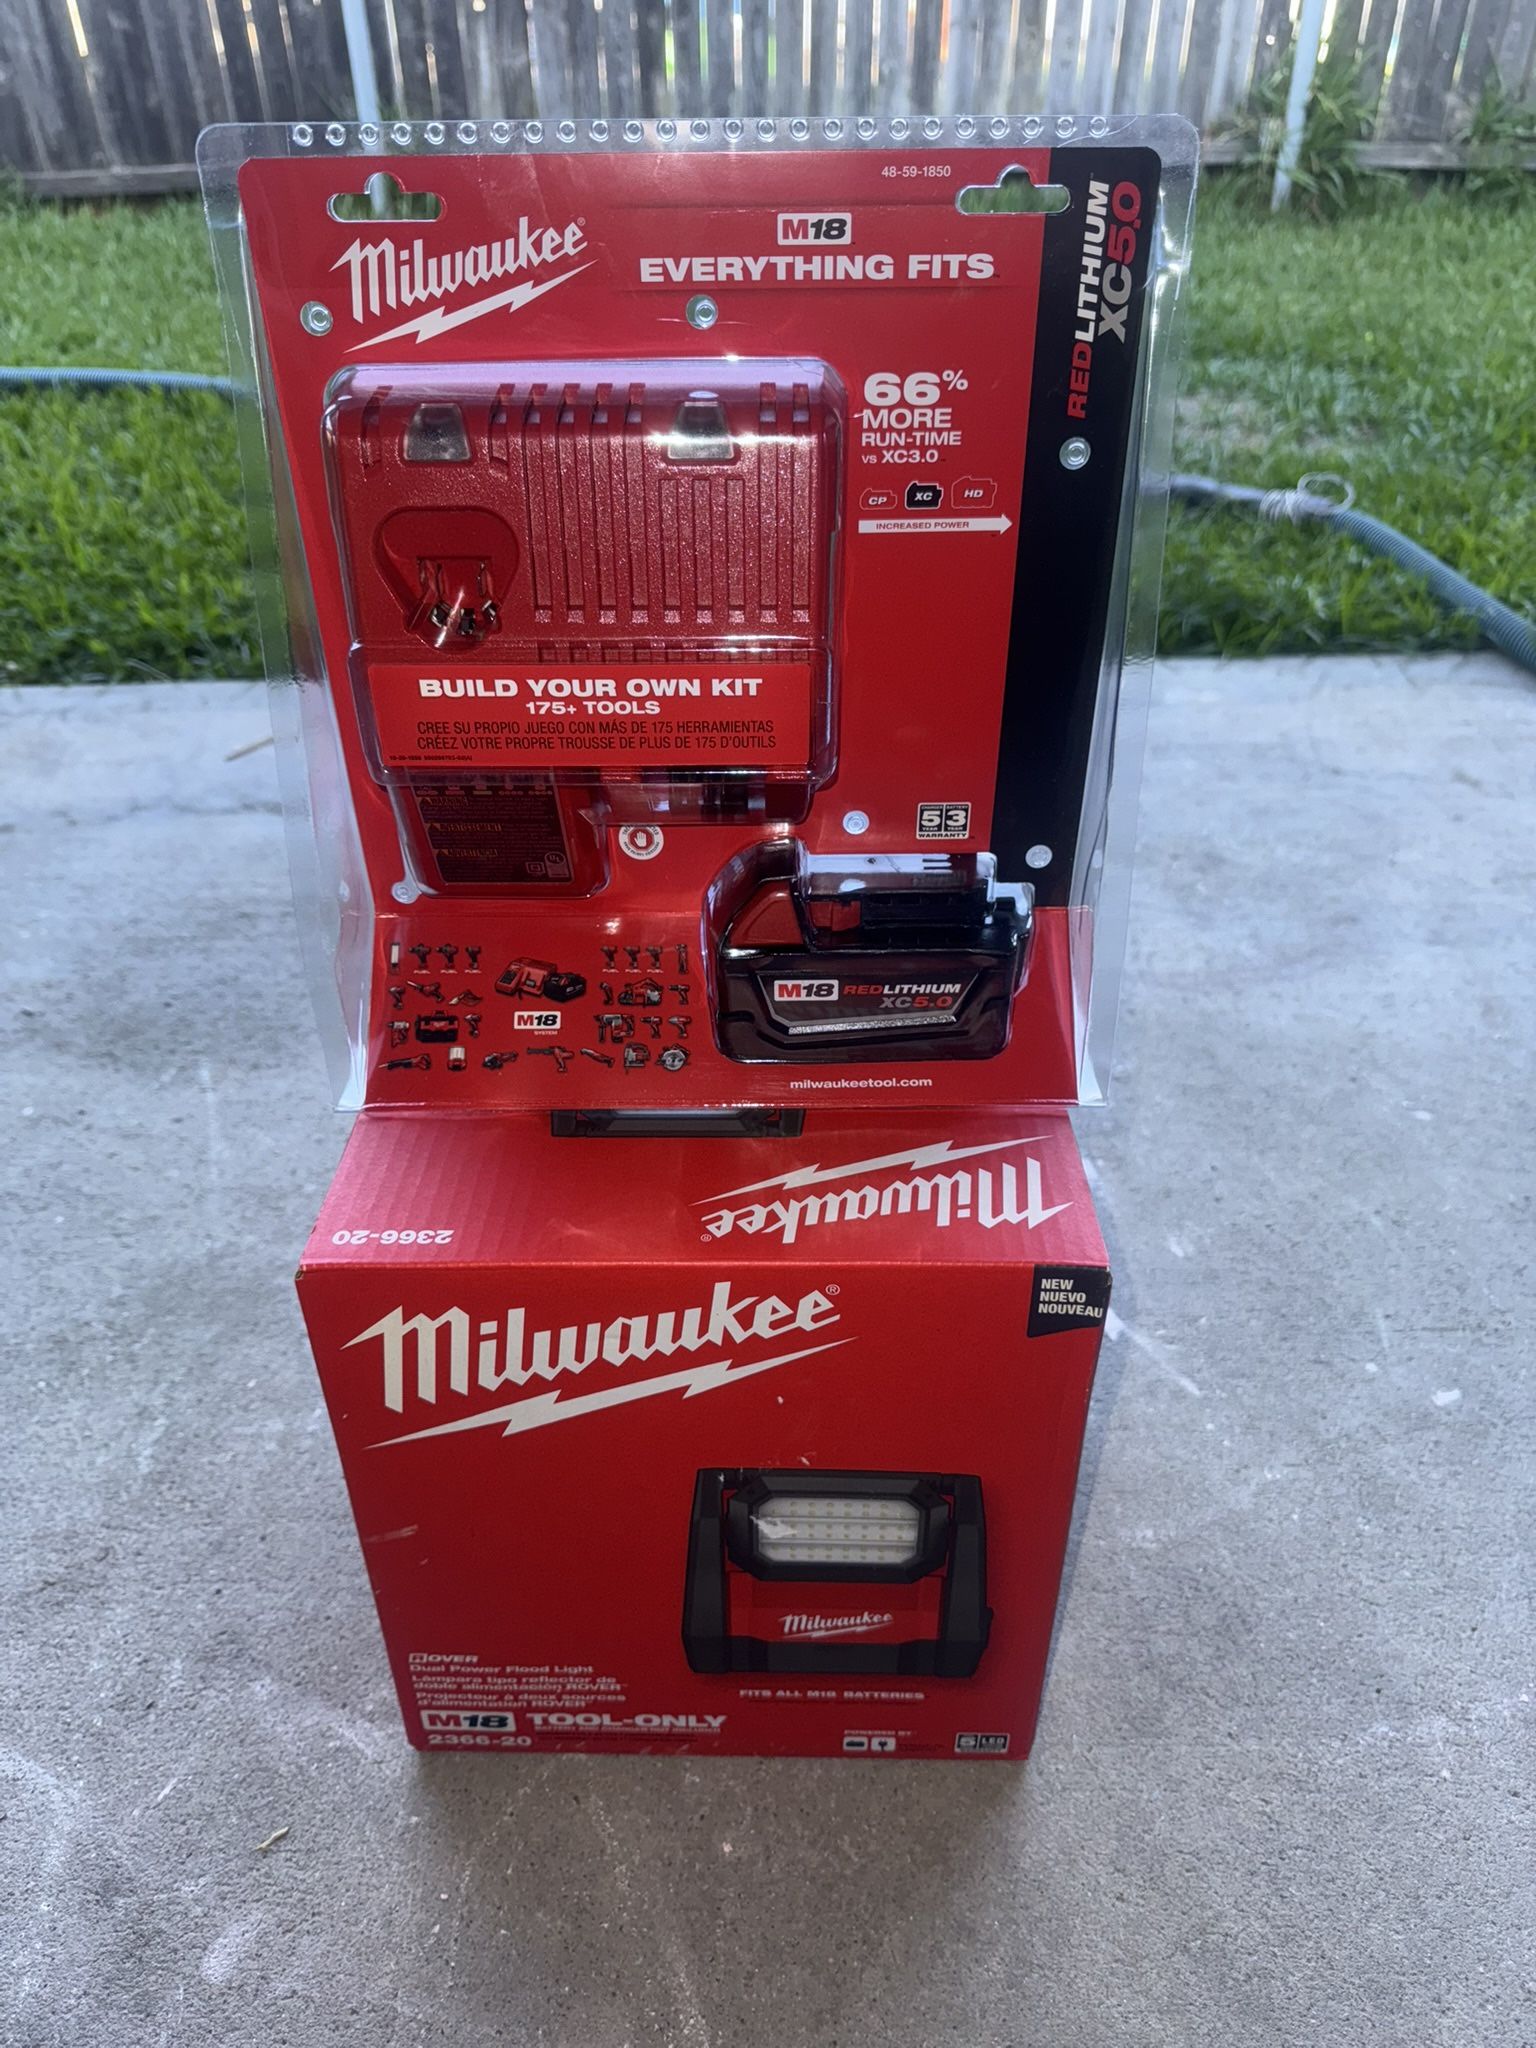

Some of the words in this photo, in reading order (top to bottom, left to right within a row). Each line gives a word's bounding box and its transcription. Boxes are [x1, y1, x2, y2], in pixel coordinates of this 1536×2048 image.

[881, 165, 951, 178] 48-59-1850
[782, 218, 847, 240] M18
[640, 254, 894, 282] EVERYTHING
[908, 253, 994, 279] FITS
[1098, 181, 1141, 344] XC5.0
[1067, 180, 1110, 419] REDLITHIUM
[864, 369, 968, 406] 66%
[862, 407, 952, 429] MORE
[861, 431, 962, 447] RUN-TIME
[881, 450, 939, 463] XC3.0
[868, 496, 887, 505] CP
[914, 492, 932, 501] XC
[964, 489, 983, 498] HD
[876, 522, 931, 530] INCREASED
[934, 521, 969, 529] POWER
[418, 678, 518, 698] BUILD
[526, 678, 617, 697] YOUR
[625, 678, 701, 697] OWN
[711, 678, 762, 697] KIT
[525, 702, 577, 715] 175+
[583, 701, 660, 714] TOOLS
[417, 721, 451, 735] CREE
[453, 721, 471, 735] SU
[474, 721, 520, 735] PROPIO
[524, 721, 565, 735] JUEGO
[568, 721, 596, 735] CON
[599, 718, 628, 735] MÁS
[631, 721, 647, 734] DE
[651, 721, 673, 734] 175
[677, 721, 774, 734] HERRAMIENTAS
[417, 734, 459, 750] CRÉEZ
[461, 737, 501, 750] VOTRE
[504, 737, 555, 750] PROPRE
[558, 737, 616, 750] TROUSSE
[619, 736, 636, 749] DE
[640, 736, 671, 749] PLUS
[674, 736, 692, 749] DE
[695, 736, 717, 749] 175
[720, 736, 776, 749] D'OUTILS
[921, 810, 941, 826] 5
[946, 810, 966, 826] 3
[778, 982, 834, 998] M18
[843, 983, 961, 995] REDLITHIUM
[879, 996, 953, 1009] XC5.0
[517, 1014, 558, 1026] M18
[790, 1077, 932, 1089] milwaukeetool.com
[332, 1229, 455, 1245] 2366-20
[1041, 1278, 1074, 1290] NEW
[1039, 1291, 1086, 1303] NUEVO
[1038, 1303, 1104, 1318] NOUVEAU
[779, 1612, 893, 1634] Milwaukee
[450, 1665, 501, 1673] Power
[554, 1666, 593, 1674] Light
[740, 1689, 772, 1697] FITS
[807, 1690, 836, 1698] M18
[843, 1691, 925, 1699] BATTERIES
[427, 1713, 508, 1728] M18
[526, 1713, 727, 1728] TOOL-ONLY
[428, 1734, 532, 1746] 2366-20
